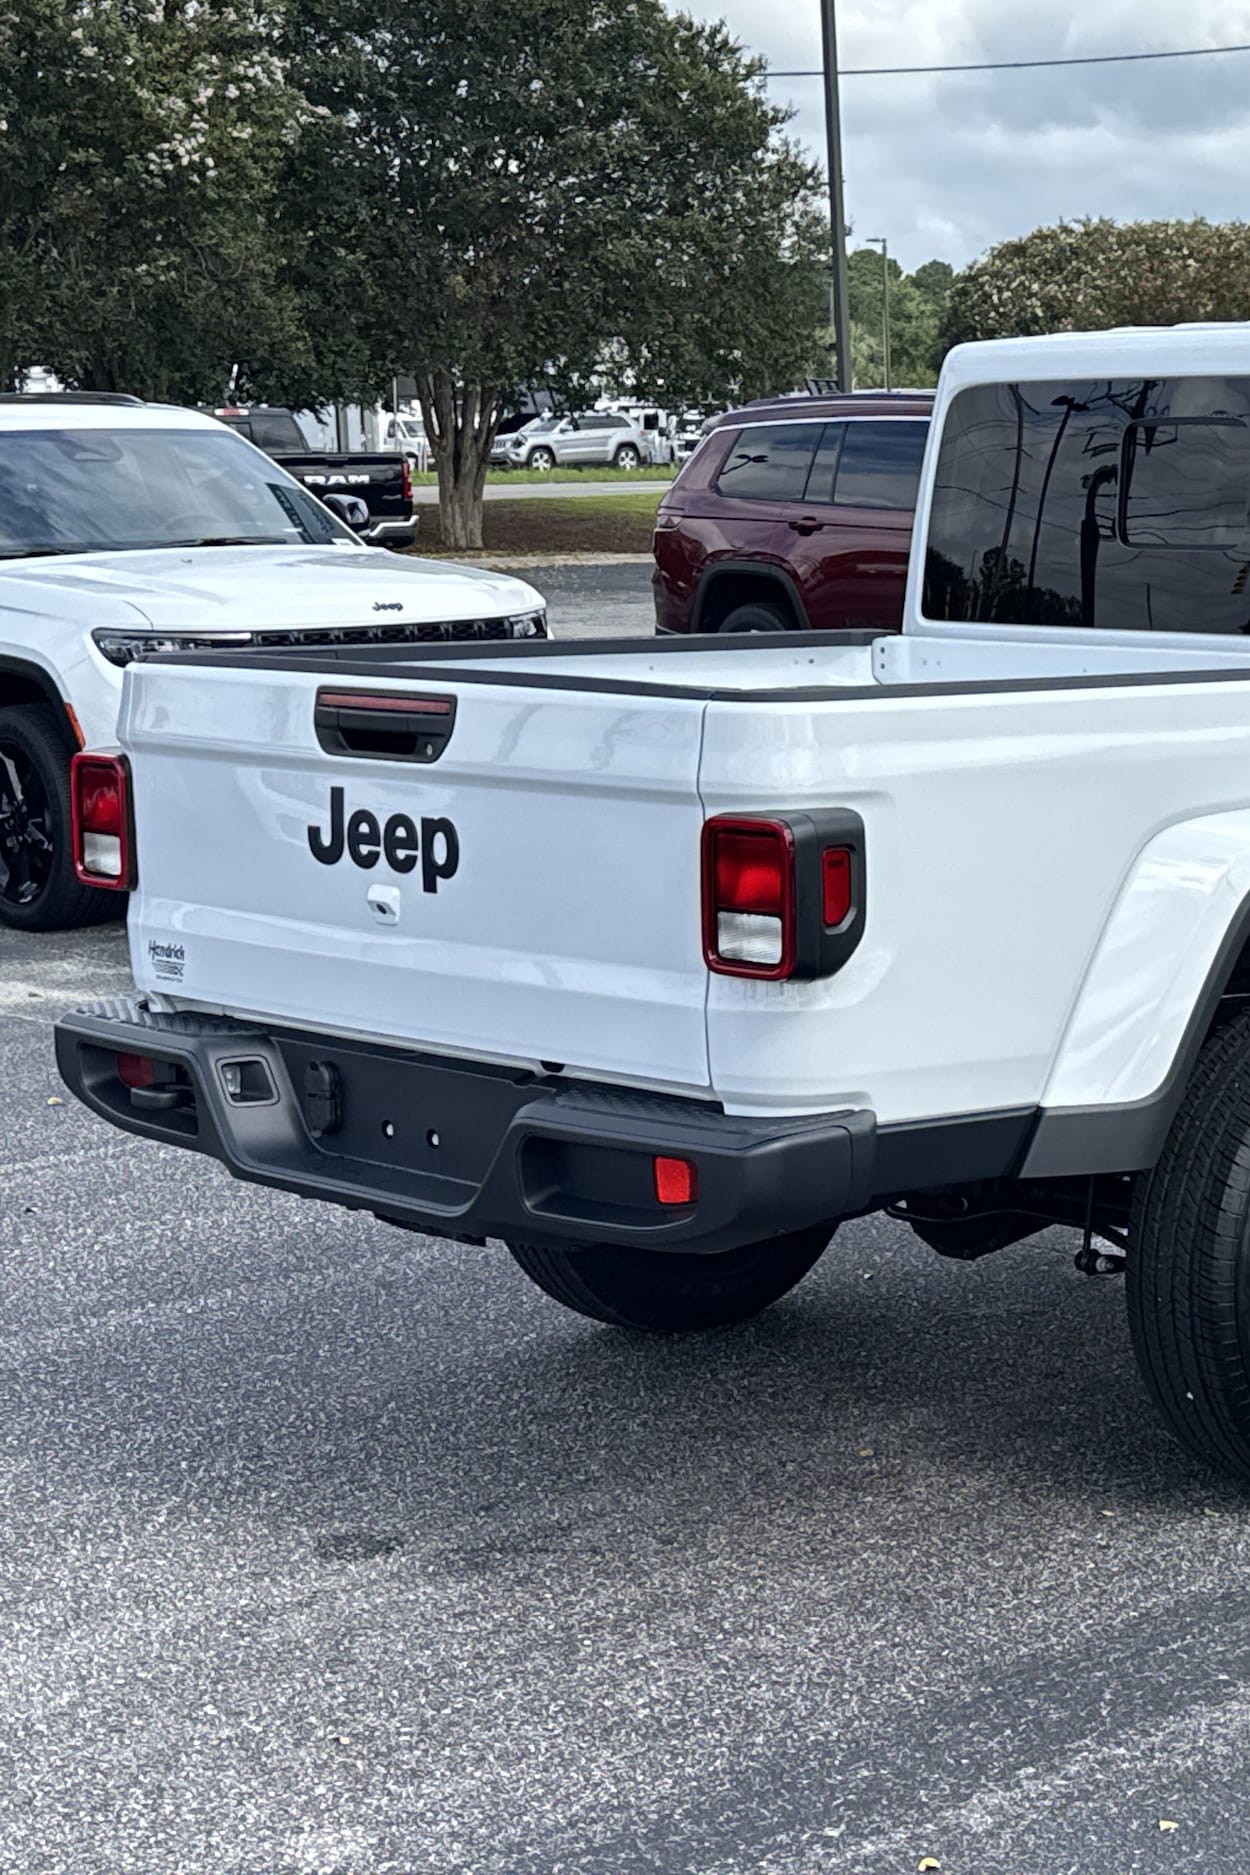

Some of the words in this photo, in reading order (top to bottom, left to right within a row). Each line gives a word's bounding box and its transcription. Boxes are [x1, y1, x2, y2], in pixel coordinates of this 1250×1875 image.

[304, 475, 370, 486] RAM
[372, 601, 403, 612] Jeep
[307, 786, 459, 893] Jeep
